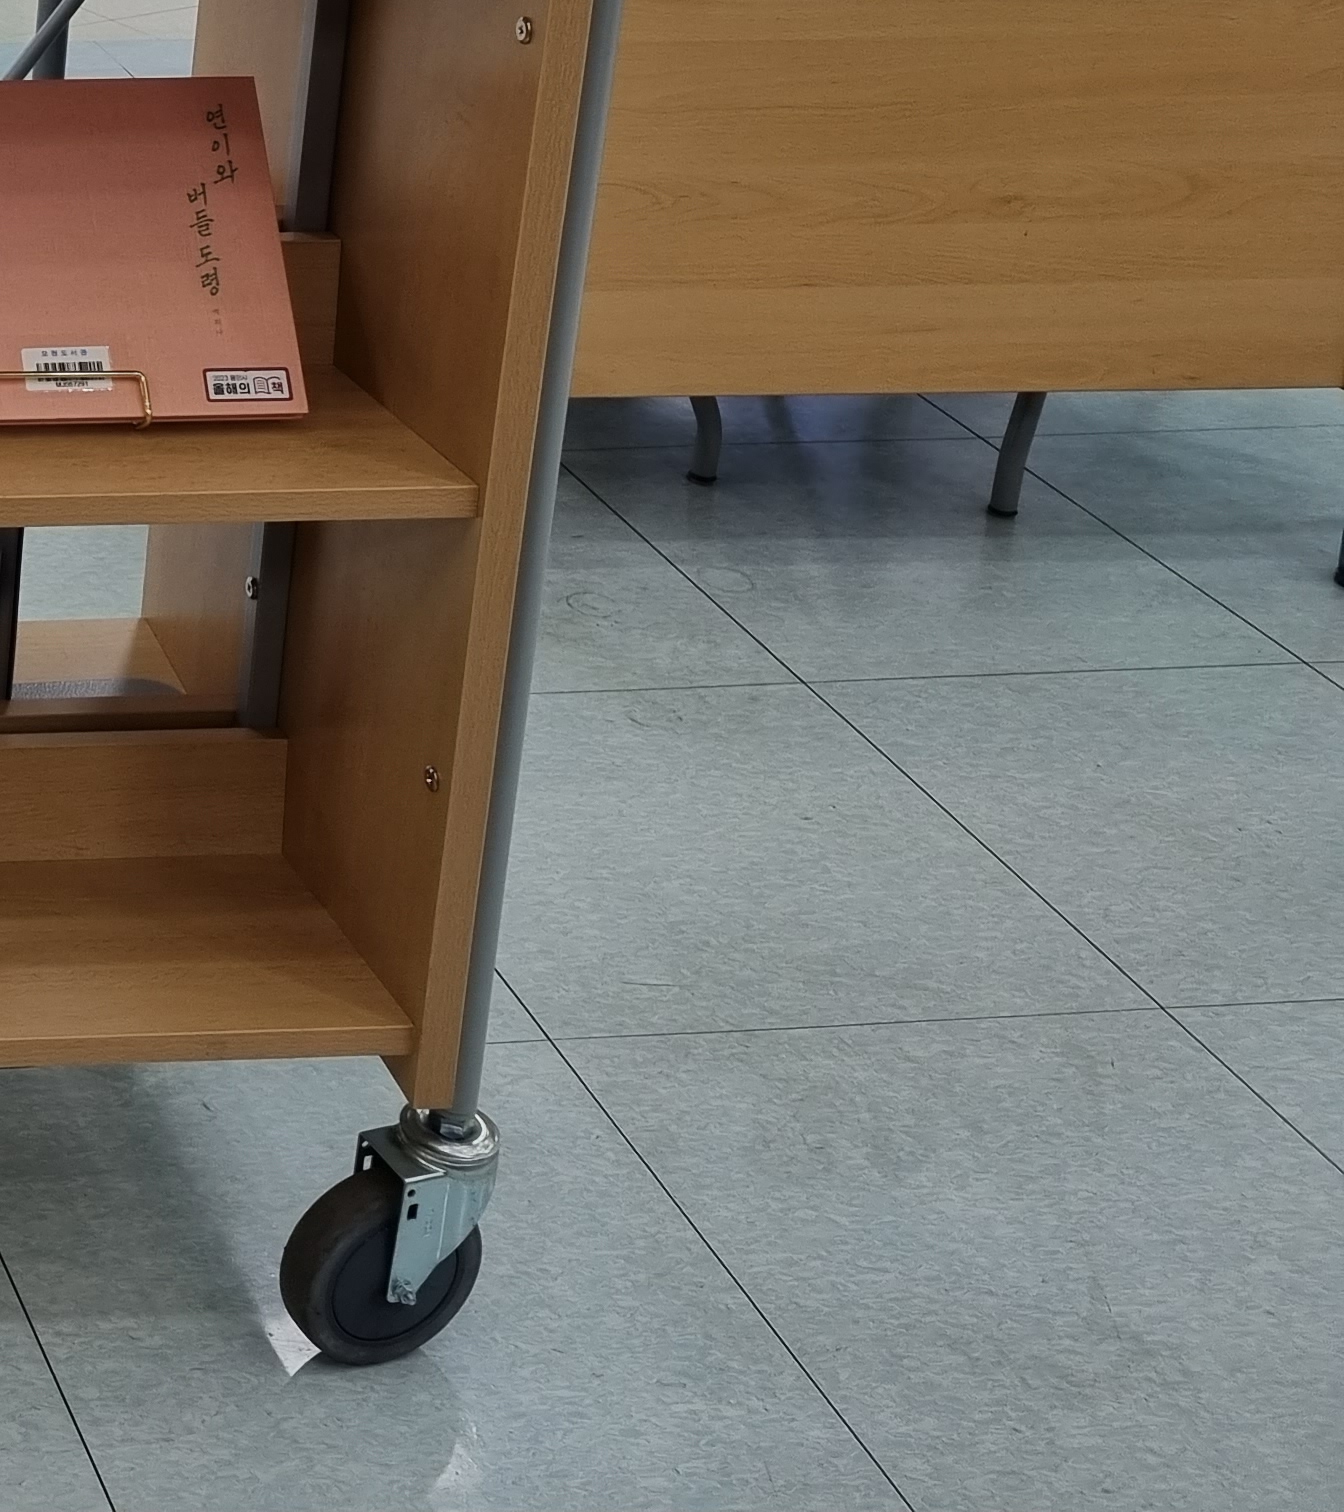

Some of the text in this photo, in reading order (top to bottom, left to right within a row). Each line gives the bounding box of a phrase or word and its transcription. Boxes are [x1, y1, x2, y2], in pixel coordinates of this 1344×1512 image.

[205, 103, 238, 186] 연이와
[186, 183, 221, 298] 버들 도령
[213, 381, 284, 395] 올해의 책
